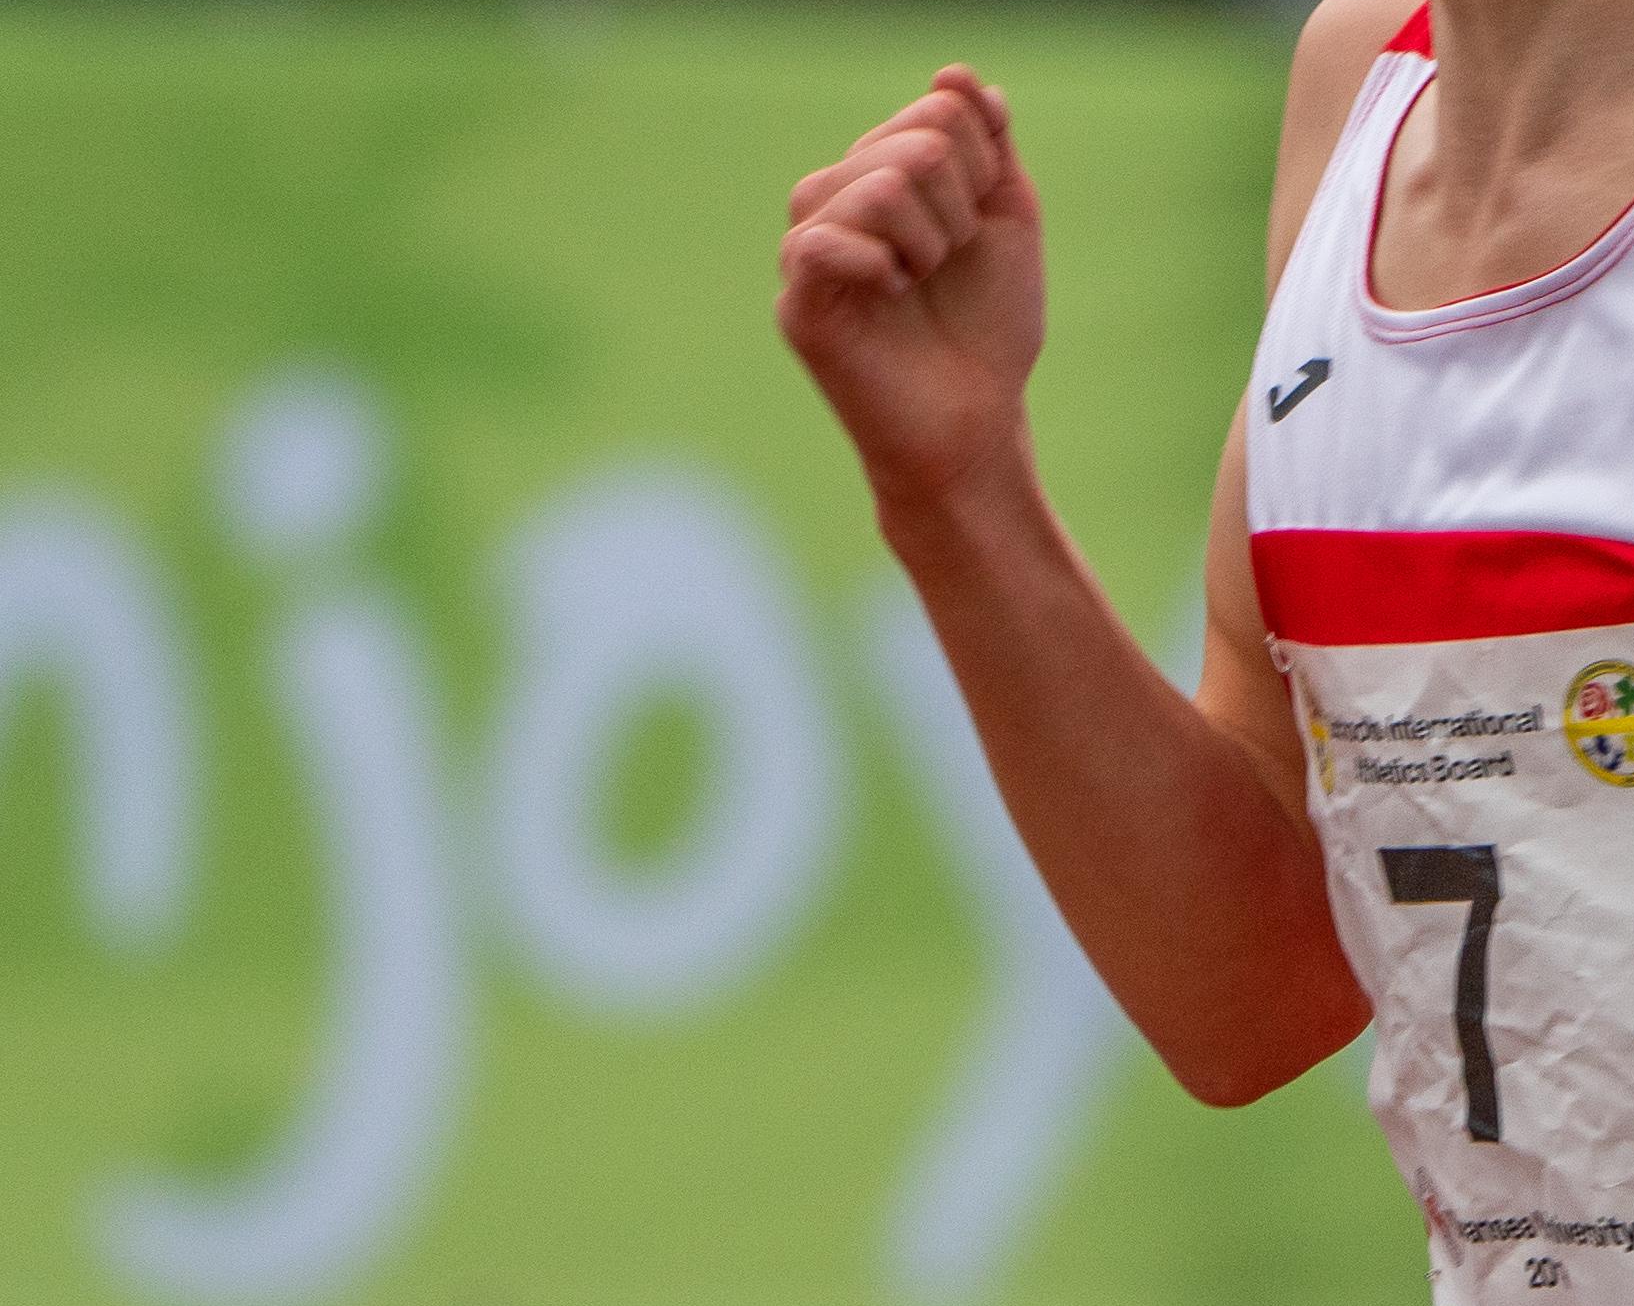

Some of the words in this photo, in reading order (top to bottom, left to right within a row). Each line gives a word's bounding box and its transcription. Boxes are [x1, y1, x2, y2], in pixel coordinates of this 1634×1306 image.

[1430, 749, 1516, 784] Board
[1378, 843, 1500, 1143] 7
[1458, 1213, 1538, 1244] ansea
